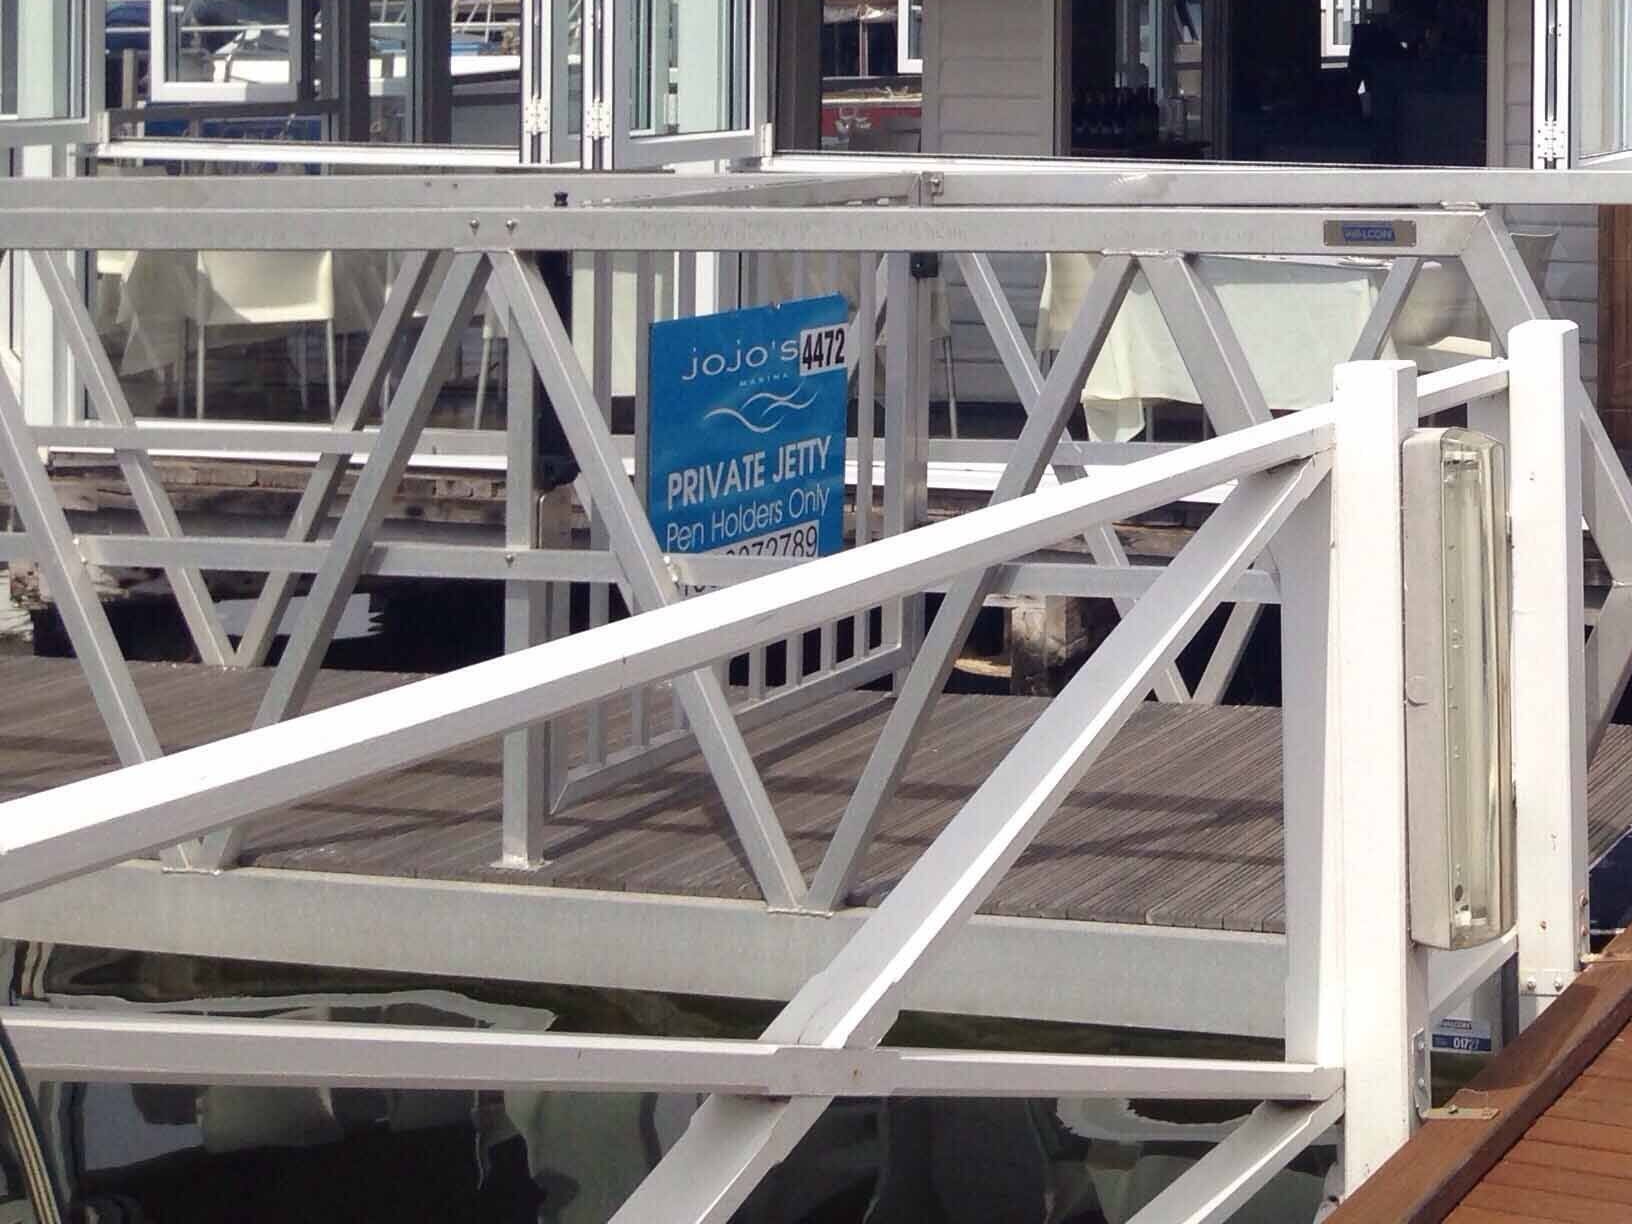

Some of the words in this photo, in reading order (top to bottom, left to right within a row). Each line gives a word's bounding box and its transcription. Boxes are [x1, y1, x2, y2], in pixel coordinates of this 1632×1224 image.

[681, 339, 799, 380] jojo's
[802, 327, 845, 371] 4472
[667, 451, 766, 512] PRIVATE
[772, 435, 832, 483] JETTY
[666, 522, 704, 553] Pen
[711, 499, 784, 543] Holders
[788, 483, 831, 519] Only
